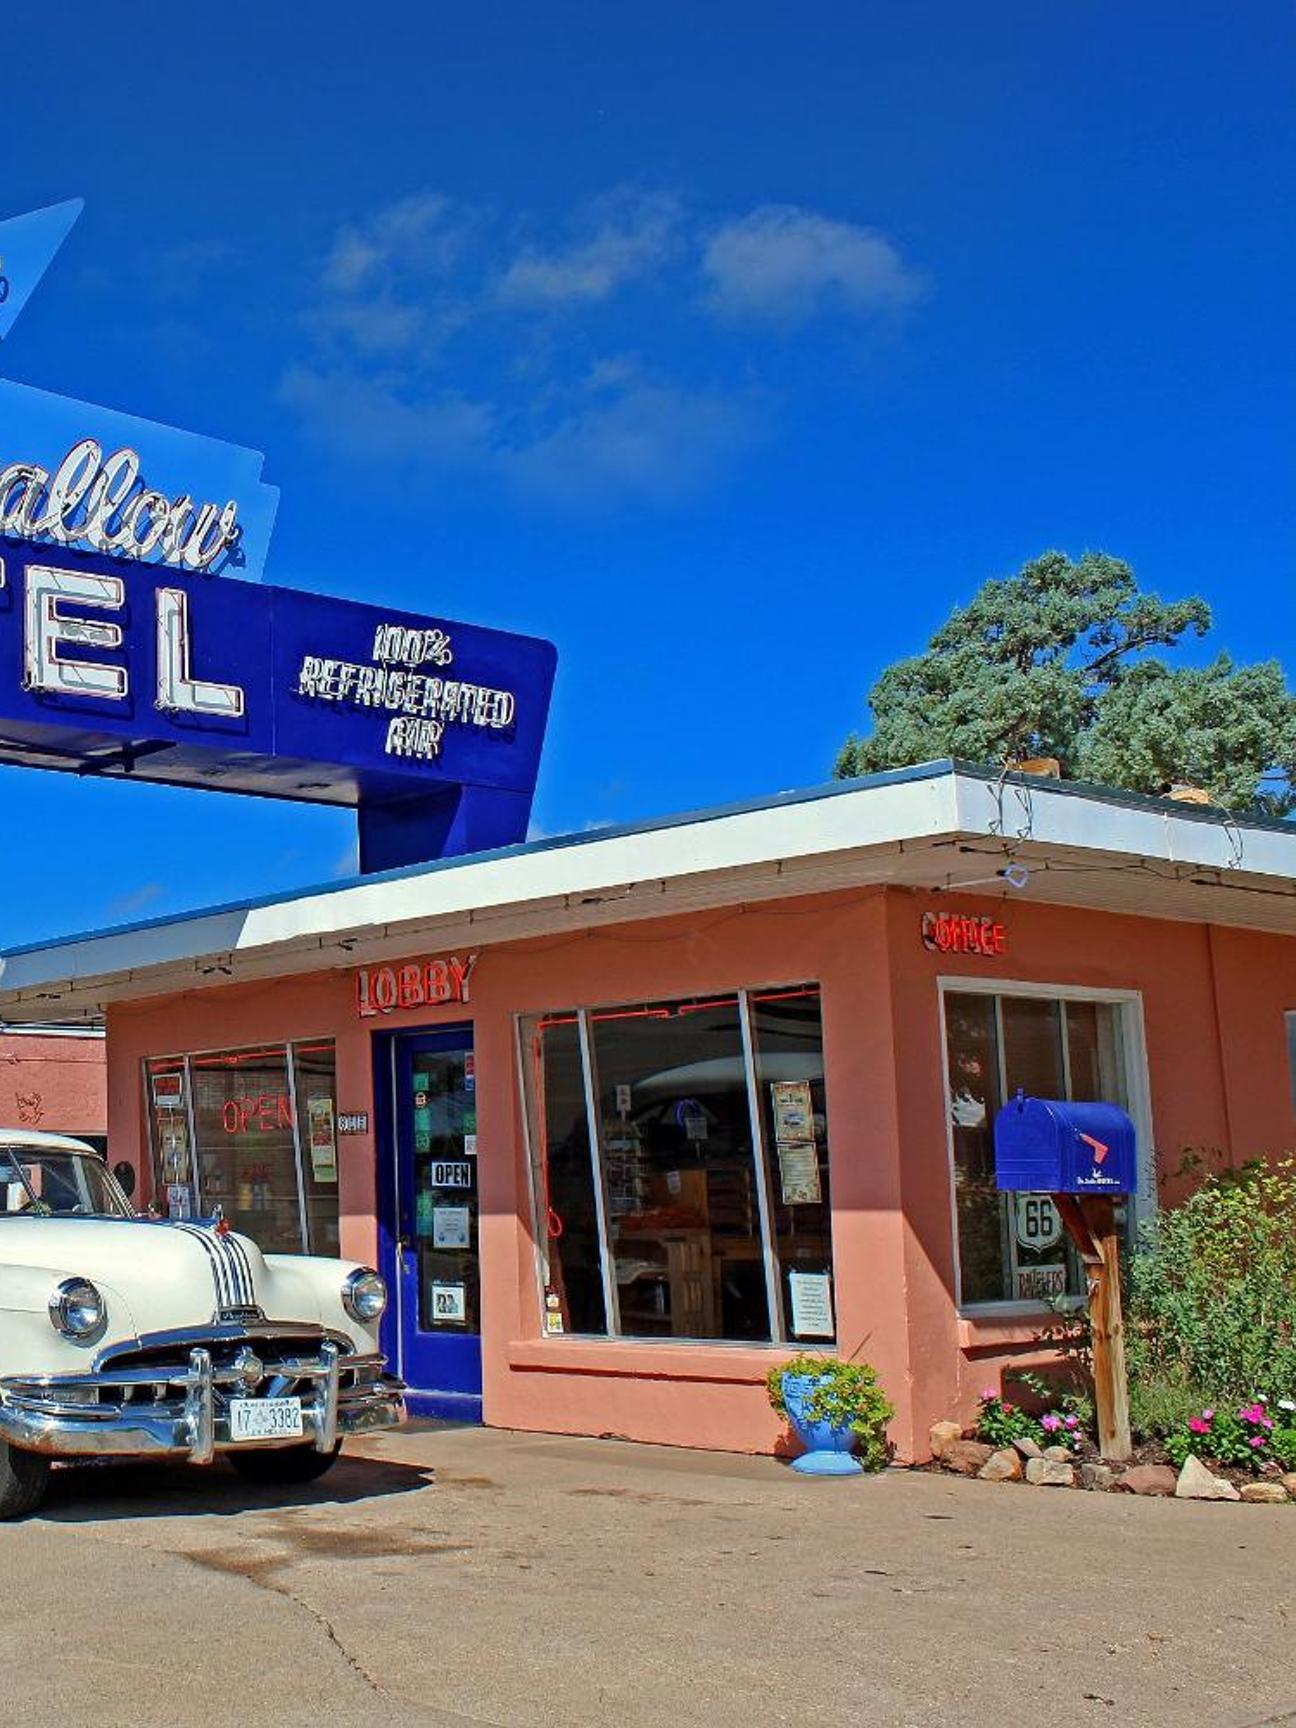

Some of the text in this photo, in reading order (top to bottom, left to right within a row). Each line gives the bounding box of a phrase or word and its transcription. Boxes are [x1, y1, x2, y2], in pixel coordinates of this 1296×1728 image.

[372, 624, 453, 666] 100%
[299, 656, 515, 728] REFRIGERATED
[385, 716, 444, 759] AIR
[921, 912, 1007, 957] OFFICE
[355, 955, 477, 1017] LOBBY
[223, 1093, 294, 1134] OPEN
[435, 1164, 469, 1184] OPEN
[1026, 1199, 1054, 1238] 66
